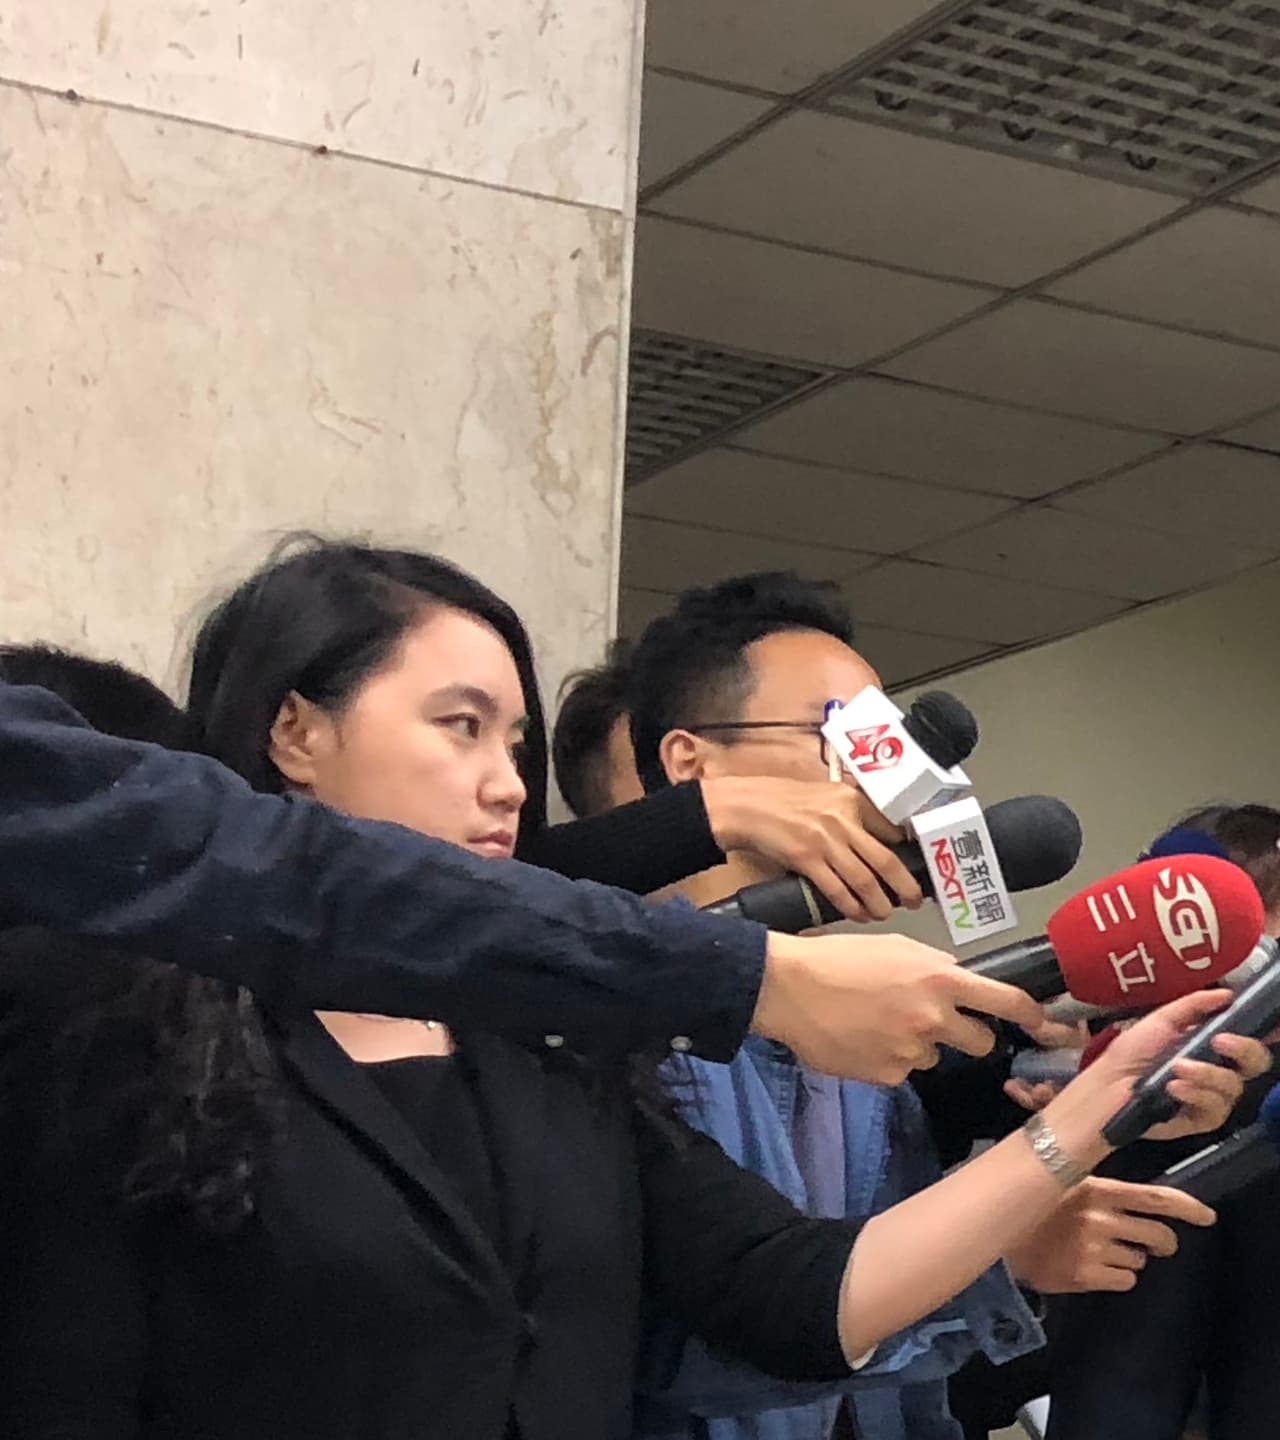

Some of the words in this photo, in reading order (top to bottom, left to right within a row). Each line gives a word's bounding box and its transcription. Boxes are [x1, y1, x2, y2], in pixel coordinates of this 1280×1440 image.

[949, 828, 1007, 928] 壹新聞
[1086, 884, 1156, 993] 三立
